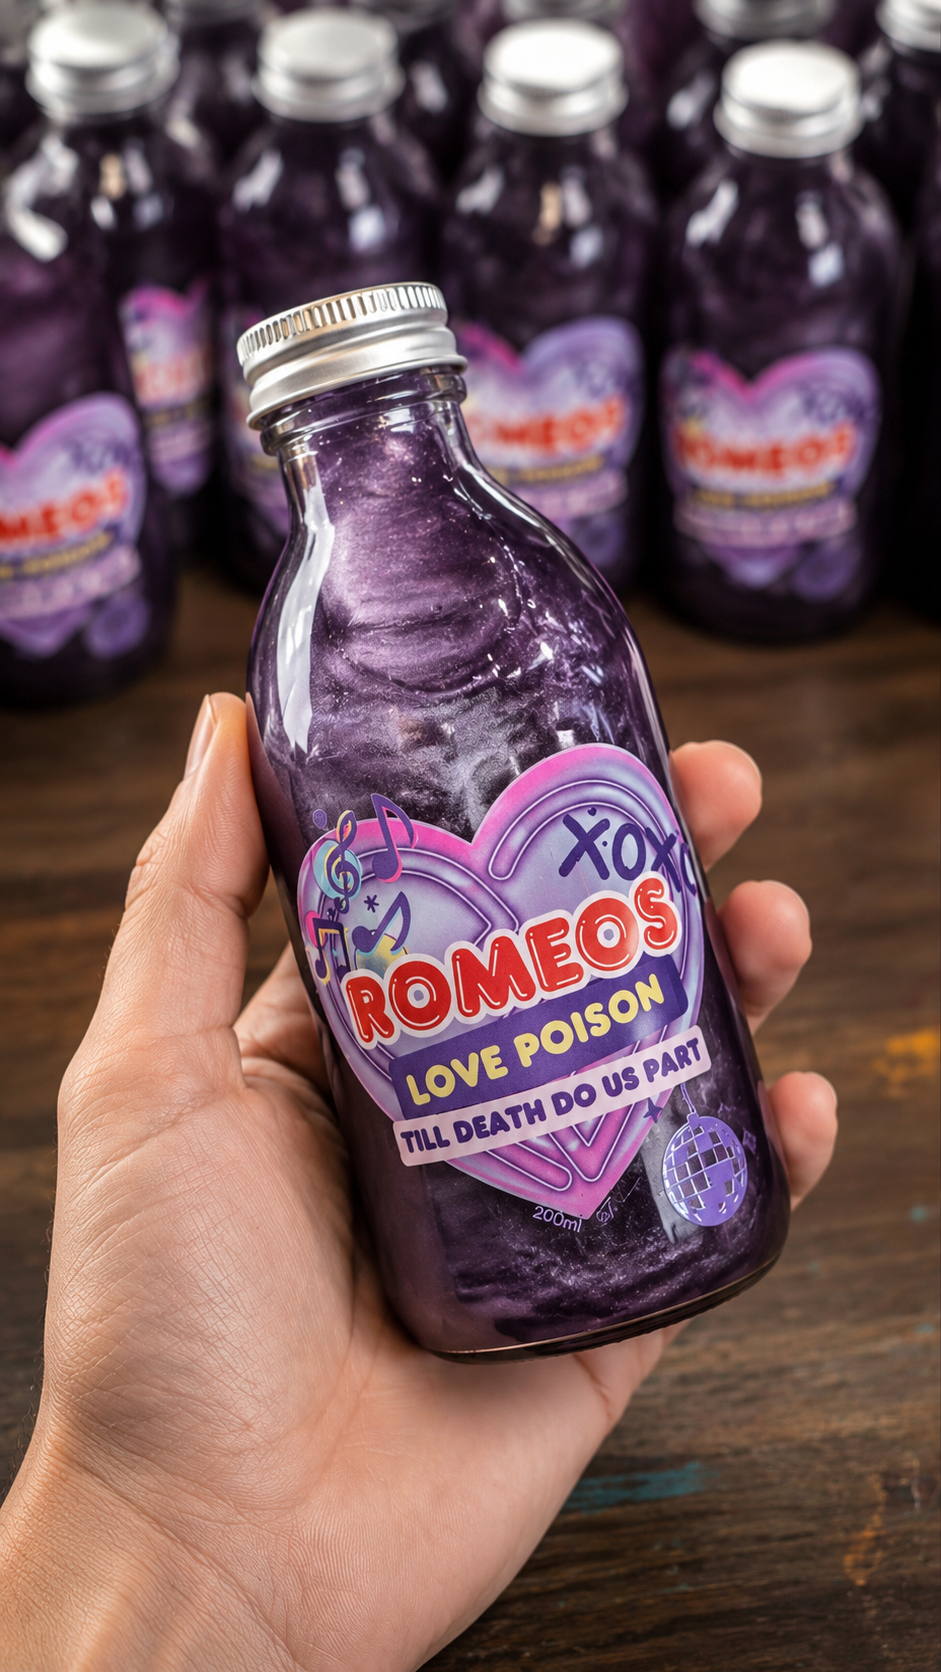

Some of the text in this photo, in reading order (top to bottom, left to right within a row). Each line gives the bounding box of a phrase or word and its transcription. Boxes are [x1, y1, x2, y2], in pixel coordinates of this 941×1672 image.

[345, 877, 678, 1044] ROMEOS
[400, 1037, 702, 1154] TILL DEATH DO US PART
[405, 973, 666, 1106] LOVE POISON
[532, 1205, 583, 1233] 200ml
